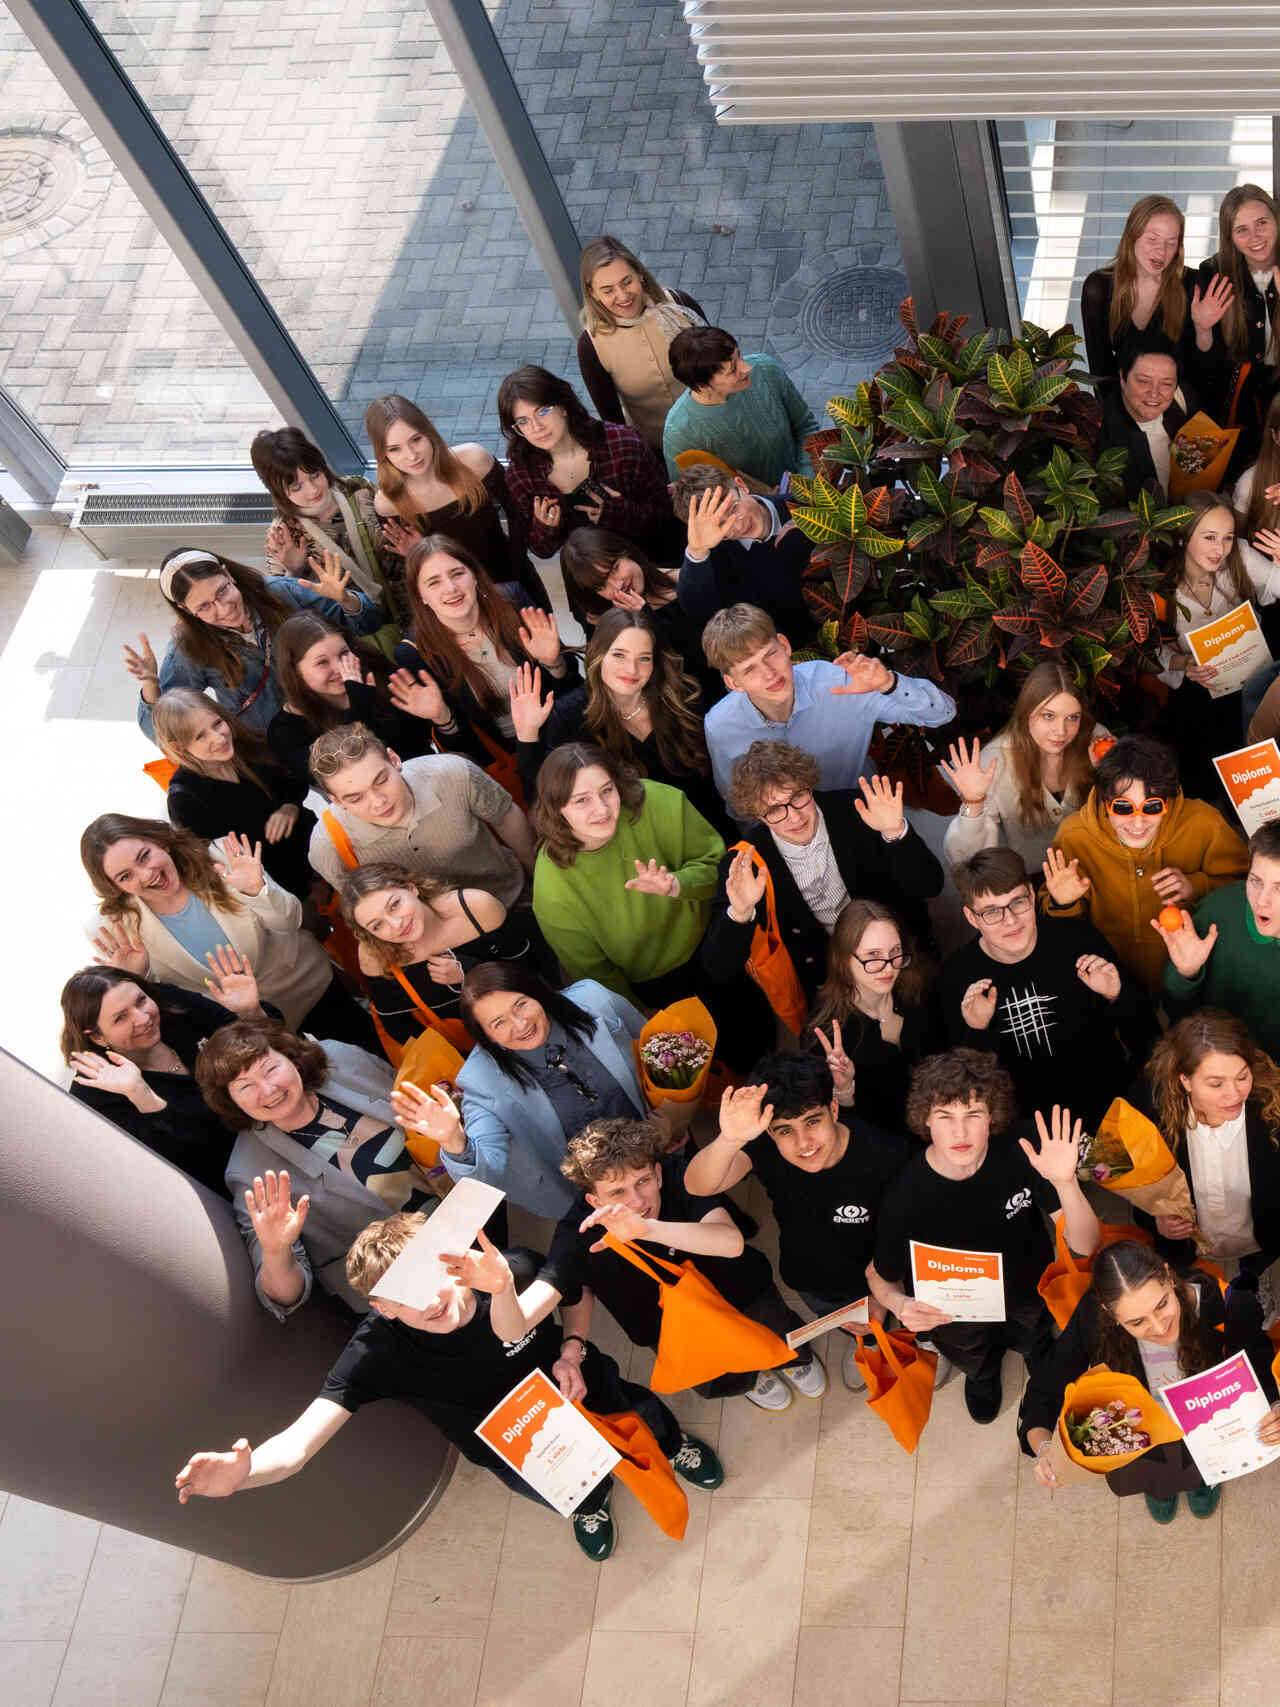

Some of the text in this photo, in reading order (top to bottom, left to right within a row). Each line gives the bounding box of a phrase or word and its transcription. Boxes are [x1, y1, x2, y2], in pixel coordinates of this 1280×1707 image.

[1203, 624, 1246, 648] Diploms
[1231, 765, 1272, 785] Diploms
[928, 1259, 984, 1273] Diploms
[1185, 1381, 1242, 1412] Diploms
[501, 1399, 547, 1444] Diploms
